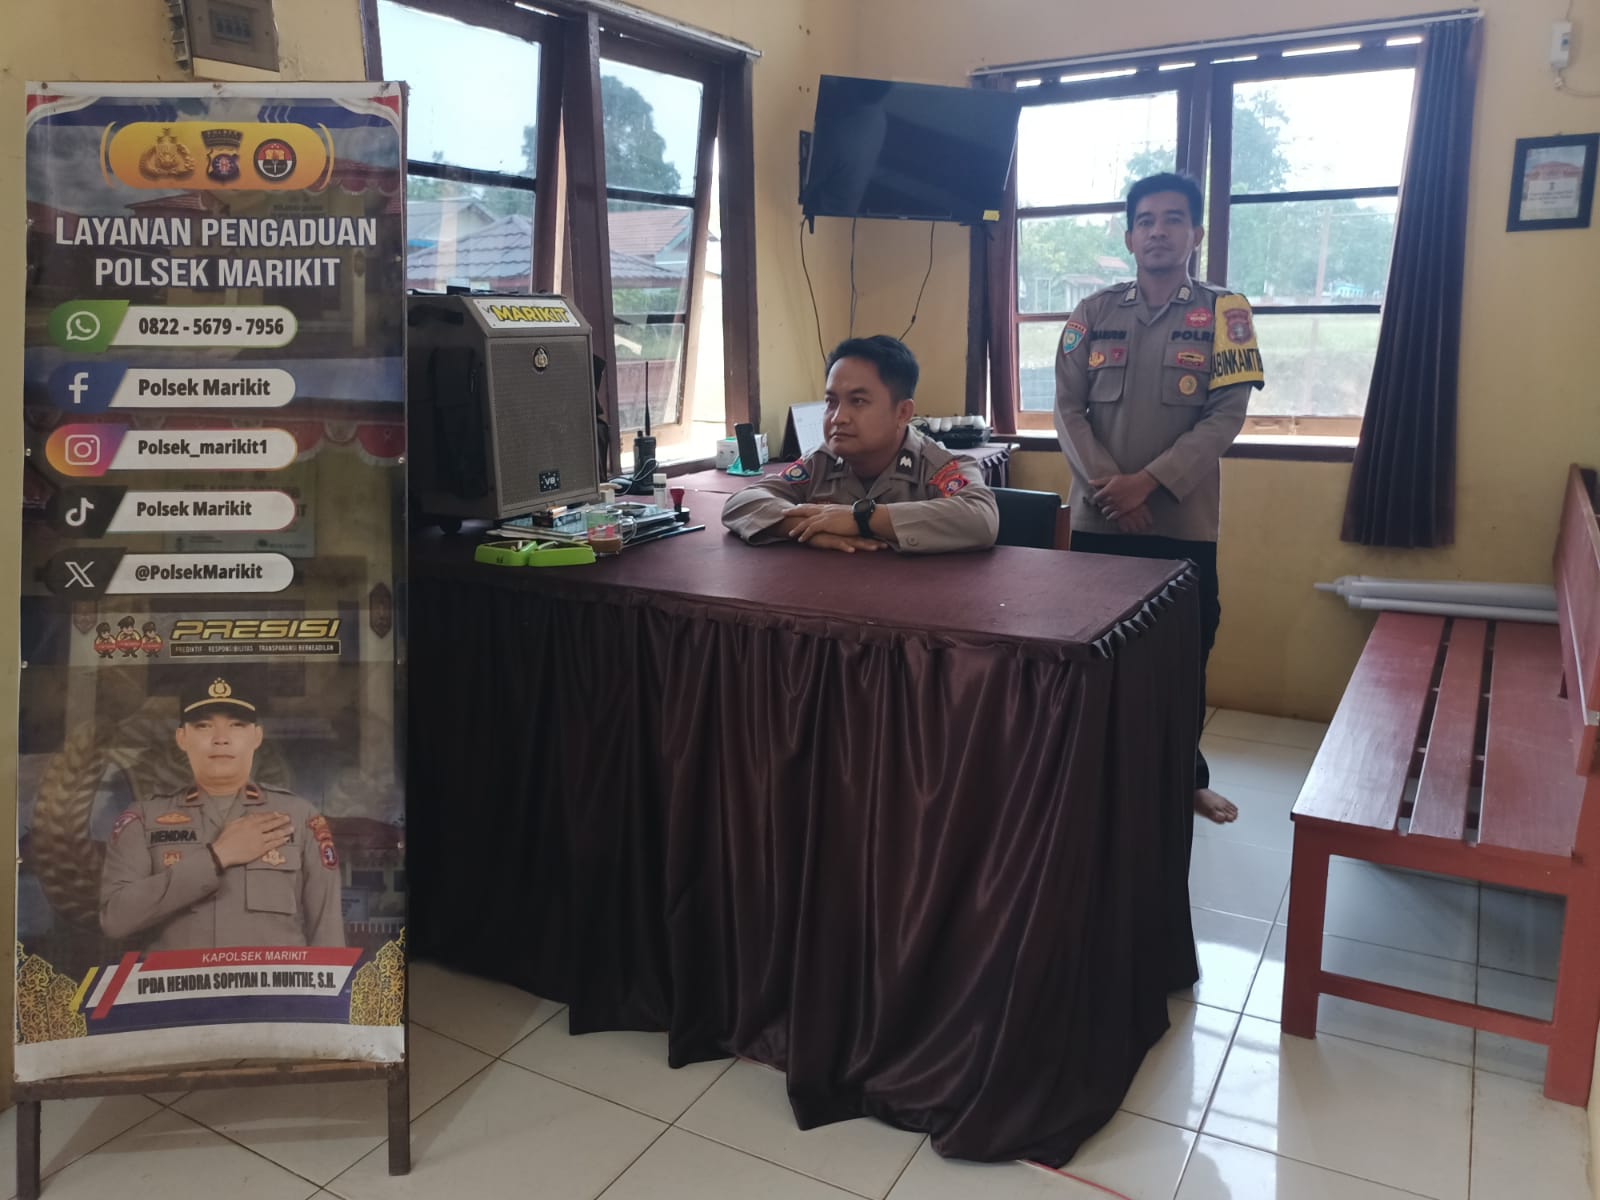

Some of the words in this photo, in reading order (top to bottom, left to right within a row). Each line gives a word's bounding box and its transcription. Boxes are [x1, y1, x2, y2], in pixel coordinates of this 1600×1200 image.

[55, 216, 192, 246] LAYANAN
[201, 217, 377, 247] PENGADUAN
[95, 257, 209, 286] POLSEK
[219, 257, 340, 287] MARIKIT
[489, 304, 570, 322] MARIKIT
[138, 317, 179, 335] 0822
[193, 316, 232, 335] 5679
[246, 316, 284, 335] 7956
[138, 378, 199, 396] Polsek
[202, 378, 270, 396] Marikit
[138, 439, 268, 458] Polsek_marikit1
[136, 501, 190, 517] Polsek
[193, 501, 252, 517] Marikit
[135, 563, 263, 581] @PolsekMarikit
[171, 618, 341, 640] PRESISI
[150, 830, 197, 844] HENDRA
[202, 951, 262, 963] KAPOLSEK
[265, 951, 308, 961] MARIKIT
[138, 977, 165, 995] IPDA
[167, 973, 211, 992] HENDRA
[213, 971, 258, 990] SOPIYAN
[260, 971, 270, 988] D.
[272, 971, 316, 989] MUNTHE,
[318, 973, 336, 988] S.H.
